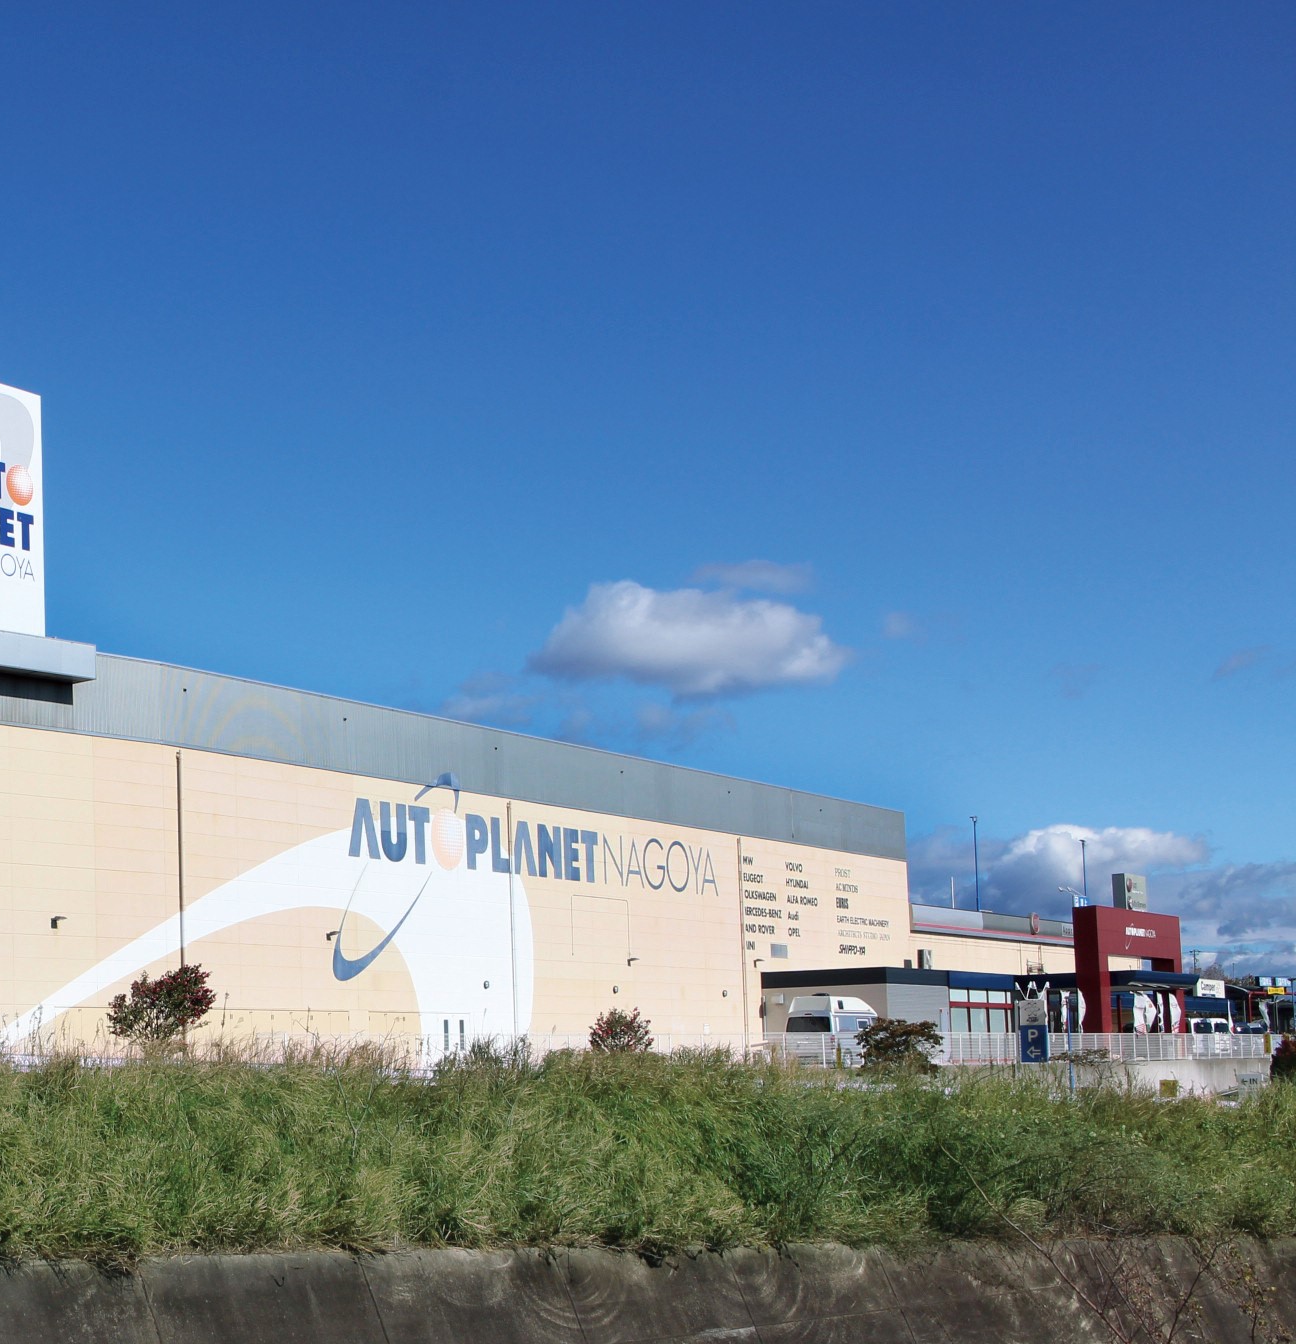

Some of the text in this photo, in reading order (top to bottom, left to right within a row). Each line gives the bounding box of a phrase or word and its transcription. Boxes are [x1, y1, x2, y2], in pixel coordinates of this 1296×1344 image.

[785, 861, 803, 873] VOLVO
[743, 872, 764, 884] EUGEOT
[785, 878, 809, 889] HYUNDAI
[744, 889, 777, 902] OLKSWAGEN
[786, 894, 819, 907] ALFA ROMEO
[744, 906, 782, 919] ERCEDES-BENZ
[745, 923, 776, 935] AND ROVER
[787, 927, 801, 938] OPEL
[1027, 1028, 1039, 1043] P
